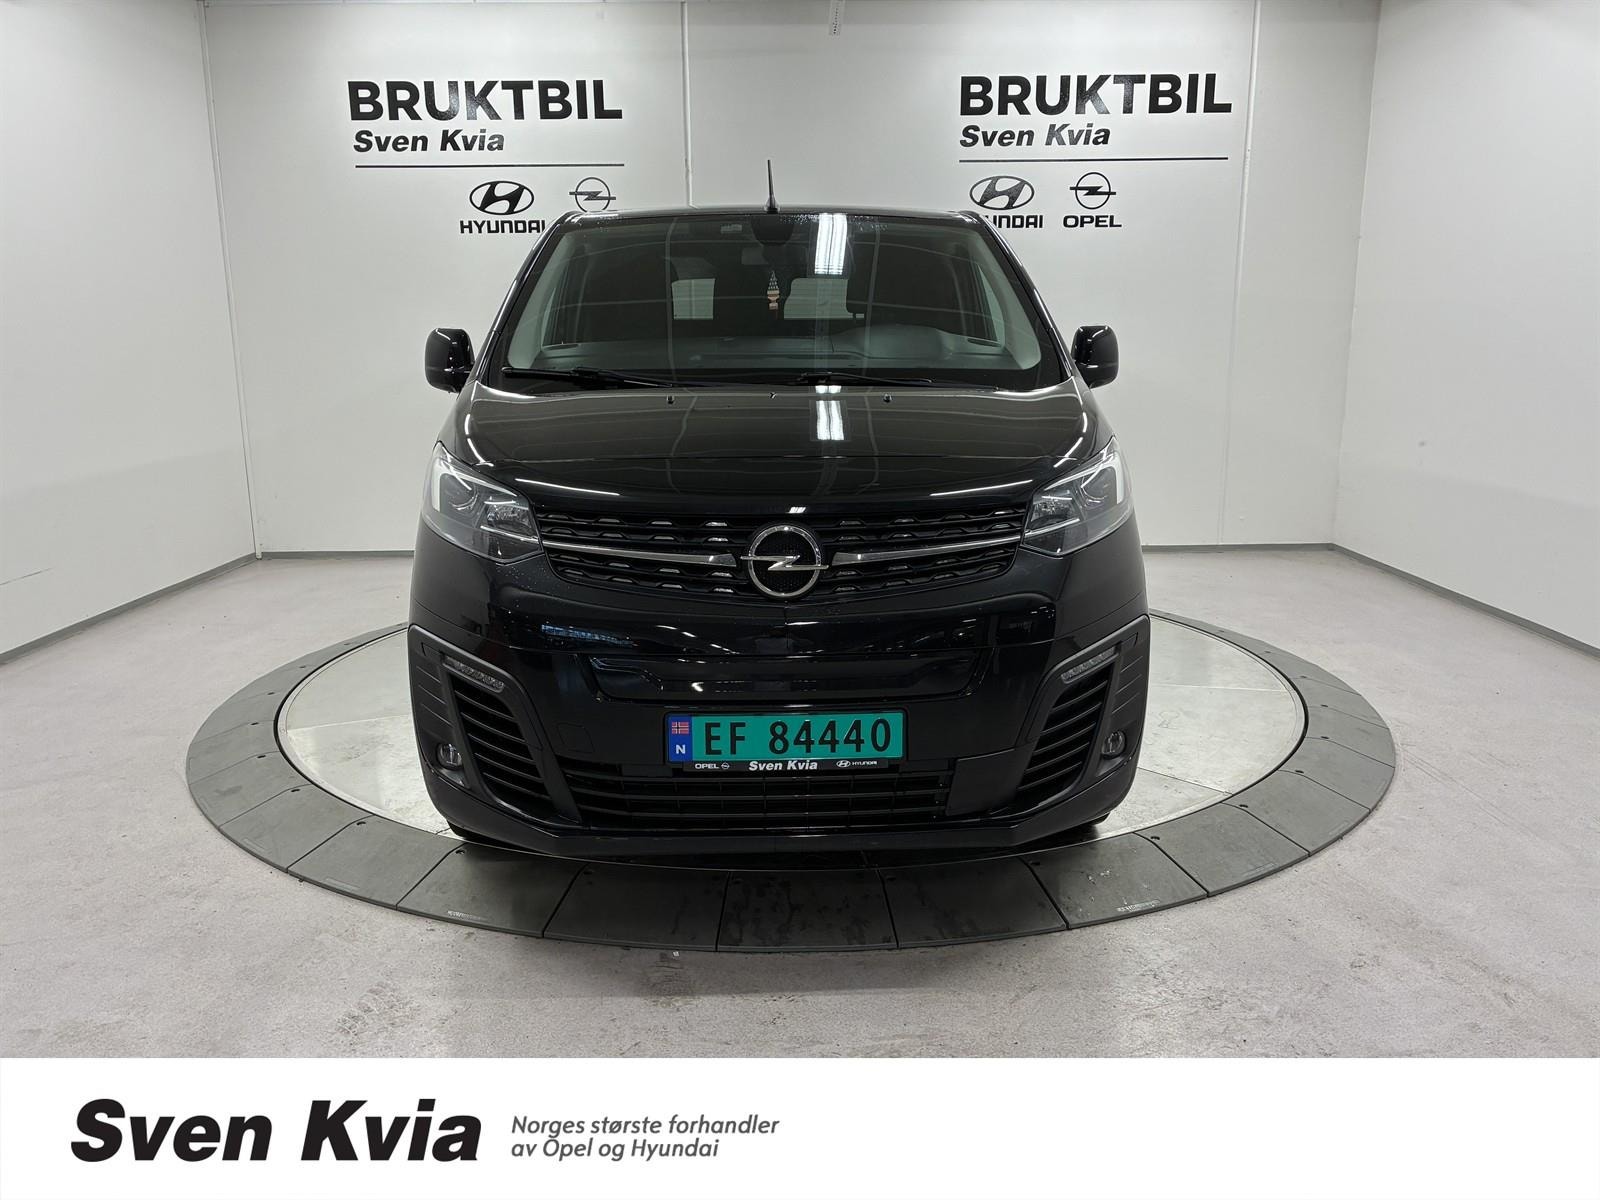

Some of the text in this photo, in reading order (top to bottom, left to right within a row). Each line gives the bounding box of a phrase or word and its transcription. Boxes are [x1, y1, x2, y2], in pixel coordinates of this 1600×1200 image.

[347, 79, 623, 122] BRUKTBIL
[959, 73, 1233, 116] BRUKTBIL
[353, 128, 505, 153] Sven Kvia
[959, 122, 1111, 148] Sven Kvia
[459, 219, 546, 234] HYUNDAI
[1062, 214, 1122, 229] OPEL
[675, 744, 686, 755] N
[704, 718, 891, 756] EF 84440
[748, 759, 818, 771] Sven Kvia
